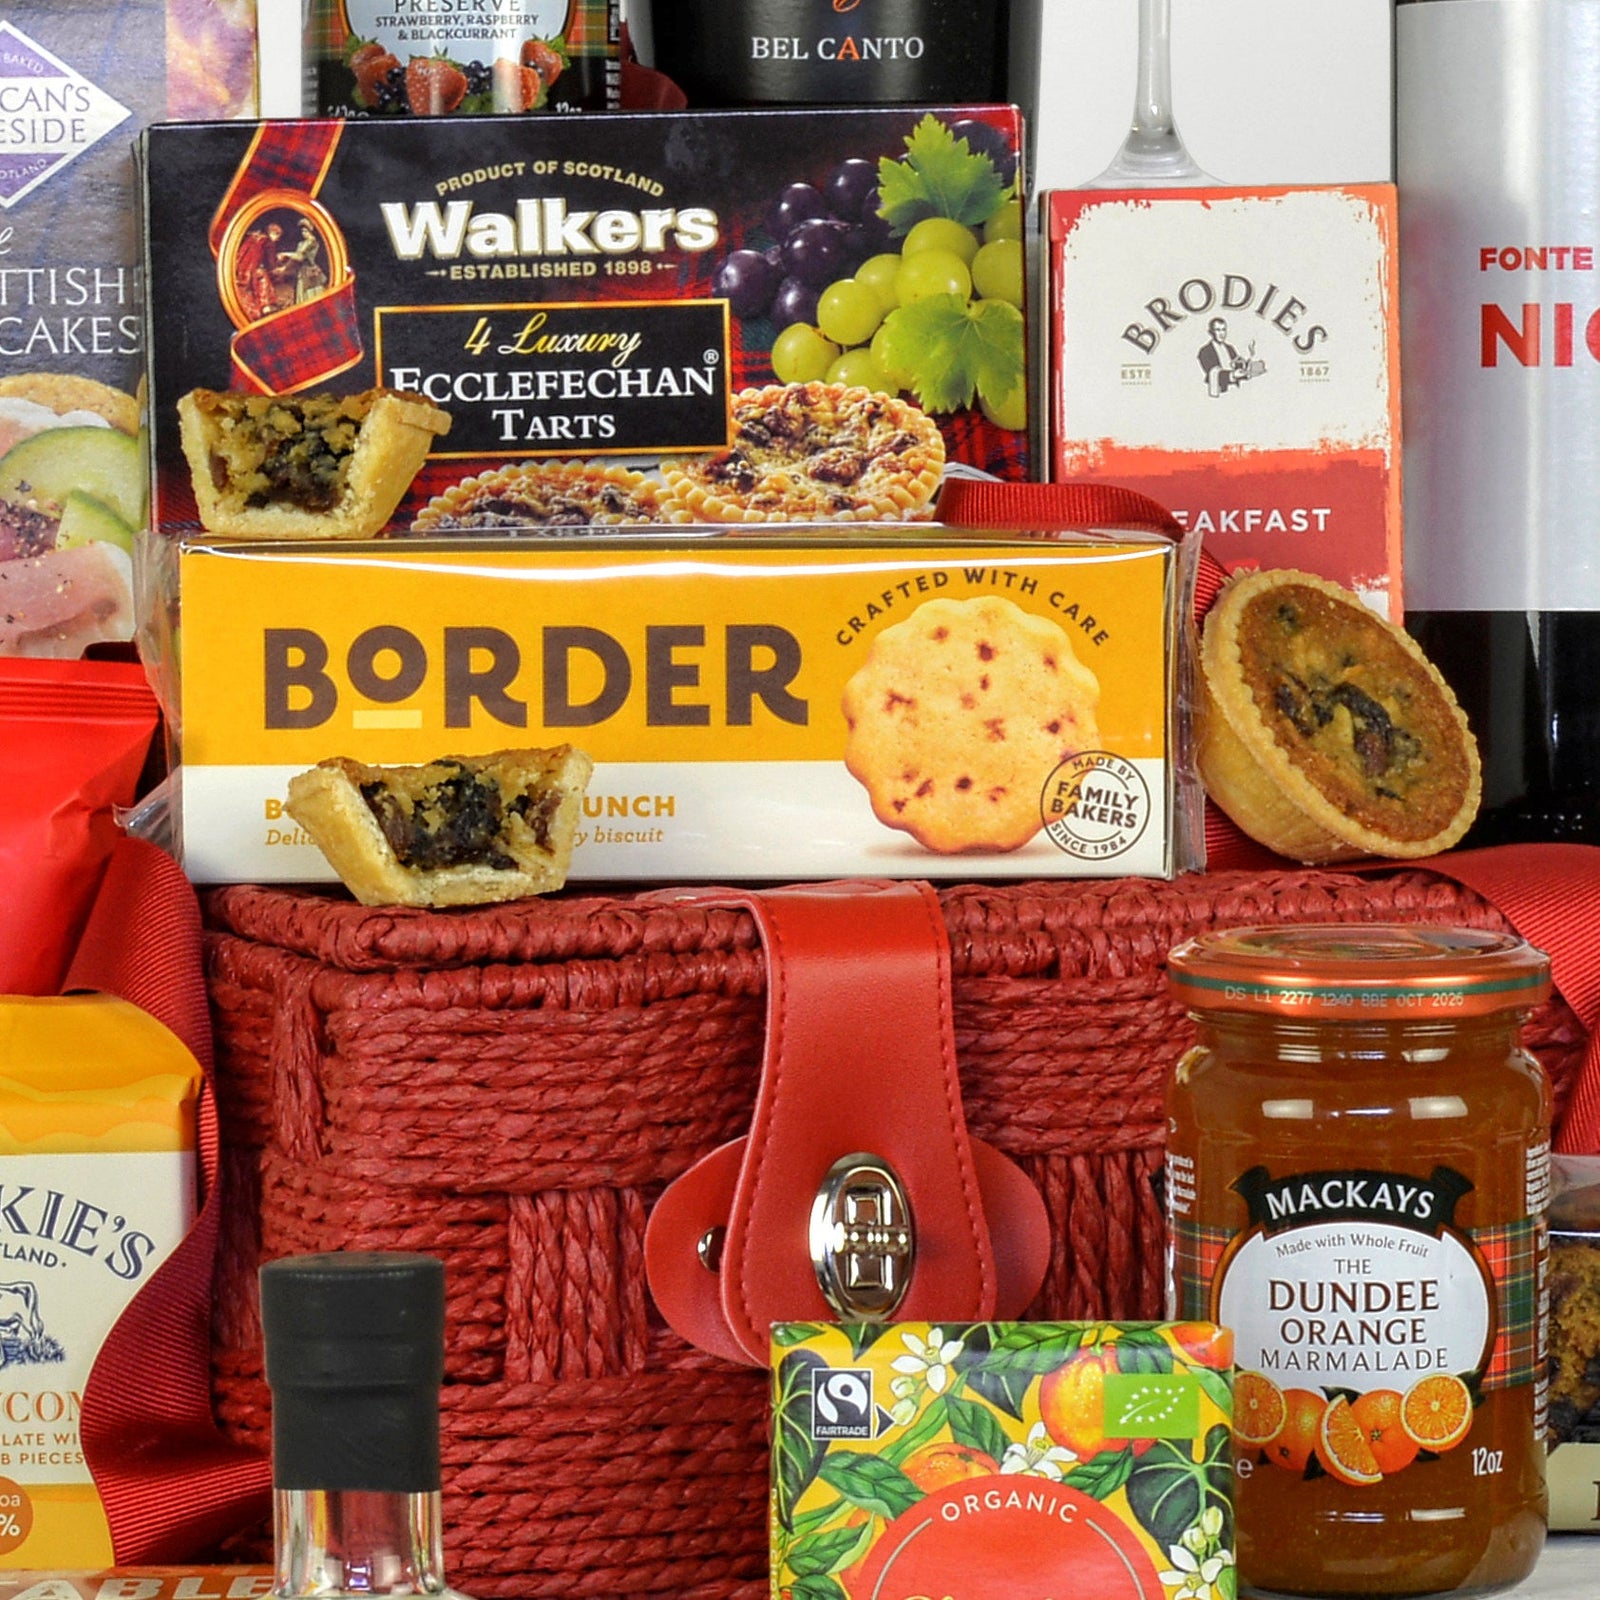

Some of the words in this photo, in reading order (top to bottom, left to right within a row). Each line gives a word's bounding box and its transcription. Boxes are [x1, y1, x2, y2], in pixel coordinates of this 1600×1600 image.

[376, 15, 464, 27] STRAWBERRY,
[466, 14, 539, 26] RASPBERRY
[394, 0, 521, 13] PRESERVE
[397, 29, 408, 40] &
[411, 28, 517, 40] BLACKCURRANT
[752, 36, 808, 60] BEL
[817, 36, 925, 61] CANTO
[4, 52, 44, 74] BAKED
[435, 161, 526, 197] PRODUCT
[533, 160, 558, 175] OF
[563, 160, 665, 198] SCOTLAND
[380, 197, 719, 261] Walkers
[450, 261, 597, 280] ESTABLISHED
[604, 259, 653, 276] 1898
[1479, 246, 1594, 272] FONTE
[1121, 273, 1329, 355] BRODIES
[464, 317, 490, 355] 4
[497, 312, 642, 367] Luxury
[1480, 303, 1600, 368] NI
[389, 366, 717, 403] ECCLEFECHAN
[1300, 367, 1330, 378] 1867
[491, 408, 617, 441] TARTS
[836, 571, 948, 646] CRAFTED
[963, 568, 1038, 595] WITH
[1048, 591, 1109, 647] CARE
[264, 624, 808, 729] BORDER
[1072, 757, 1115, 770] MADE
[1118, 765, 1135, 781] BY
[1057, 780, 1140, 810] FAMILY
[1051, 798, 1138, 829] BAKERS
[594, 826, 664, 843] biscuit
[1051, 823, 1088, 854] SINCE
[1092, 836, 1127, 854] 1984
[1225, 985, 1247, 1000] DS
[1254, 991, 1272, 1004] L1
[1279, 990, 1314, 1005] 2277
[1396, 992, 1425, 1008] OCT
[1265, 1180, 1436, 1221] MACKAYS
[1276, 1239, 1312, 1258] Made
[1315, 1234, 1346, 1248] with
[1350, 1233, 1396, 1250] Whole
[1398, 1238, 1429, 1258] Fruit
[1333, 1258, 1372, 1275] THE
[1268, 1279, 1439, 1312] DUNDEE
[1280, 1318, 1428, 1346] ORANGE
[1260, 1347, 1449, 1372] MARMALADE
[816, 1426, 868, 1436] FAIRTRADE
[20, 1452, 84, 1465] PIECES
[1471, 1446, 1503, 1477] 12oz
[941, 1489, 1078, 1524] ORGANIC
